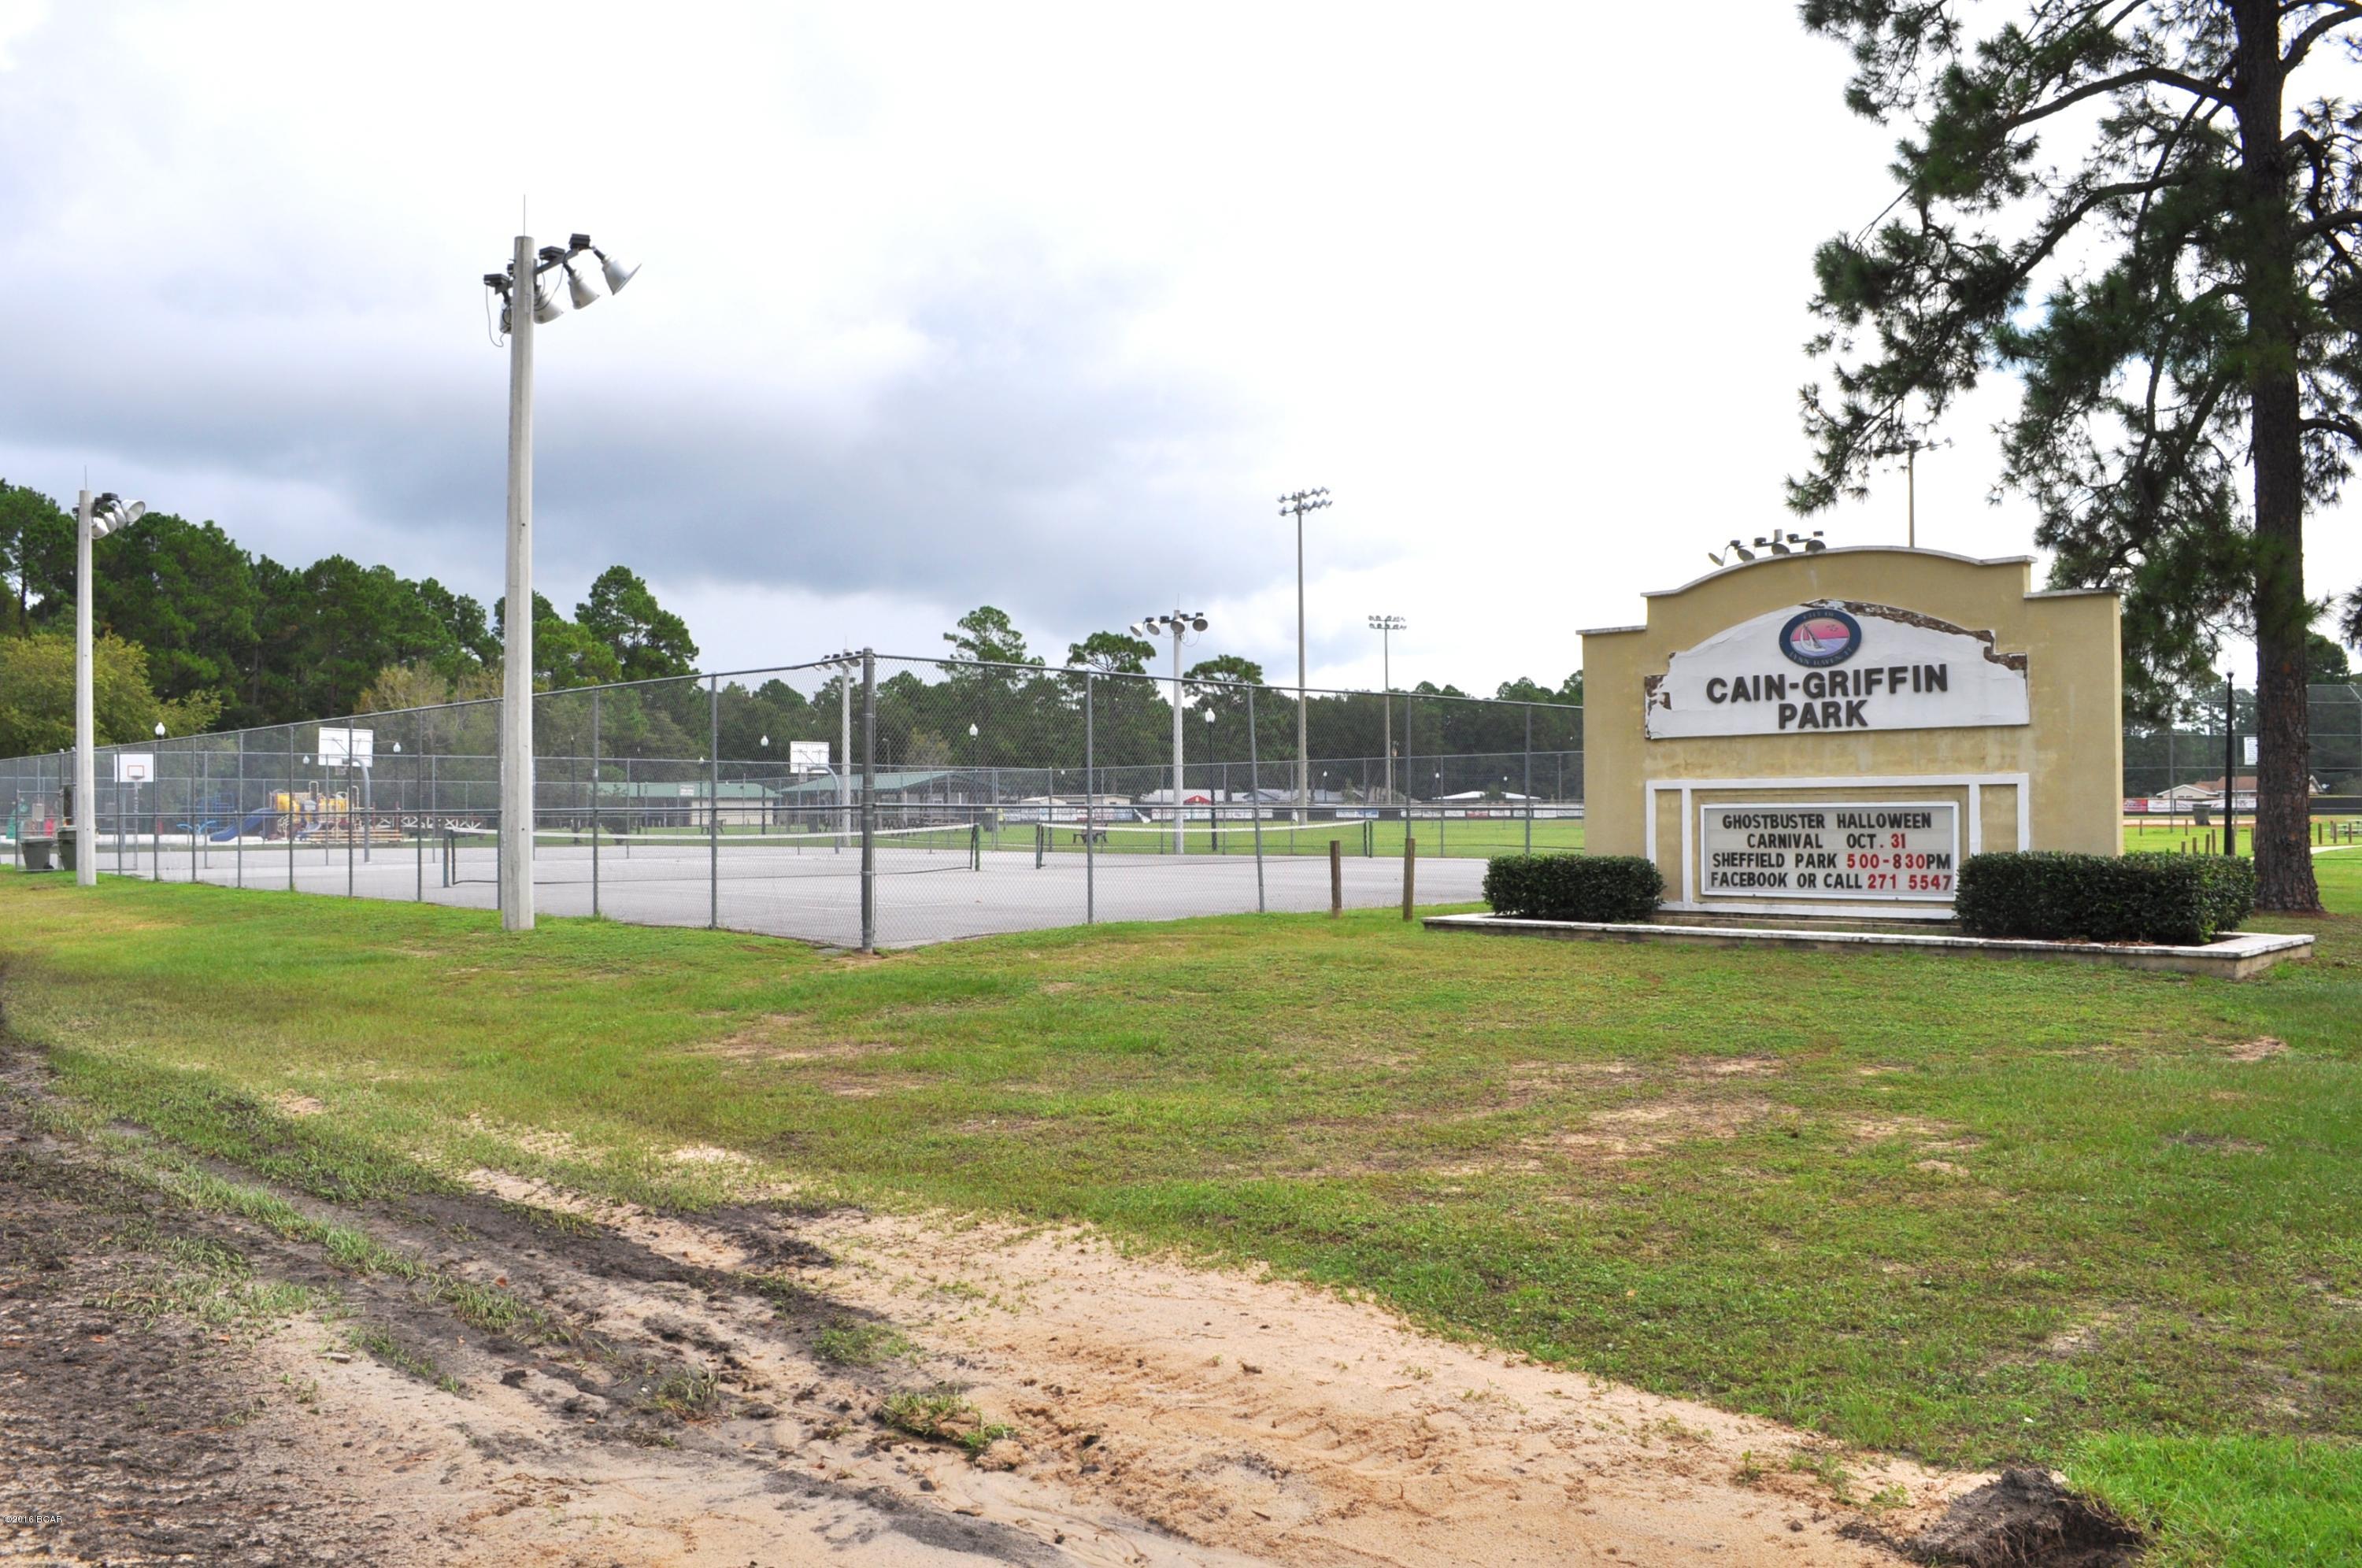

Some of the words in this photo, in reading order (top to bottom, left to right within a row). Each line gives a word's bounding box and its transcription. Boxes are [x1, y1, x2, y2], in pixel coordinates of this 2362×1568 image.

[1705, 664, 1948, 704] CAIN-GRIFFIN
[1779, 699, 1868, 730] PARK
[1722, 814, 1825, 829] GHOSTBUSTER
[1837, 812, 1931, 829] HALLOWEEN
[1747, 833, 1823, 849] CARNIVAL
[1891, 833, 1906, 849] 31
[1712, 852, 1785, 867] SHEFFIELD
[1795, 852, 1837, 868] PARK
[1711, 871, 1788, 887] FACEBOOK
[1797, 873, 1816, 888] OR
[1823, 873, 1863, 889] CALL
[1868, 874, 1897, 889] 271
[1908, 875, 1953, 890] 5547
